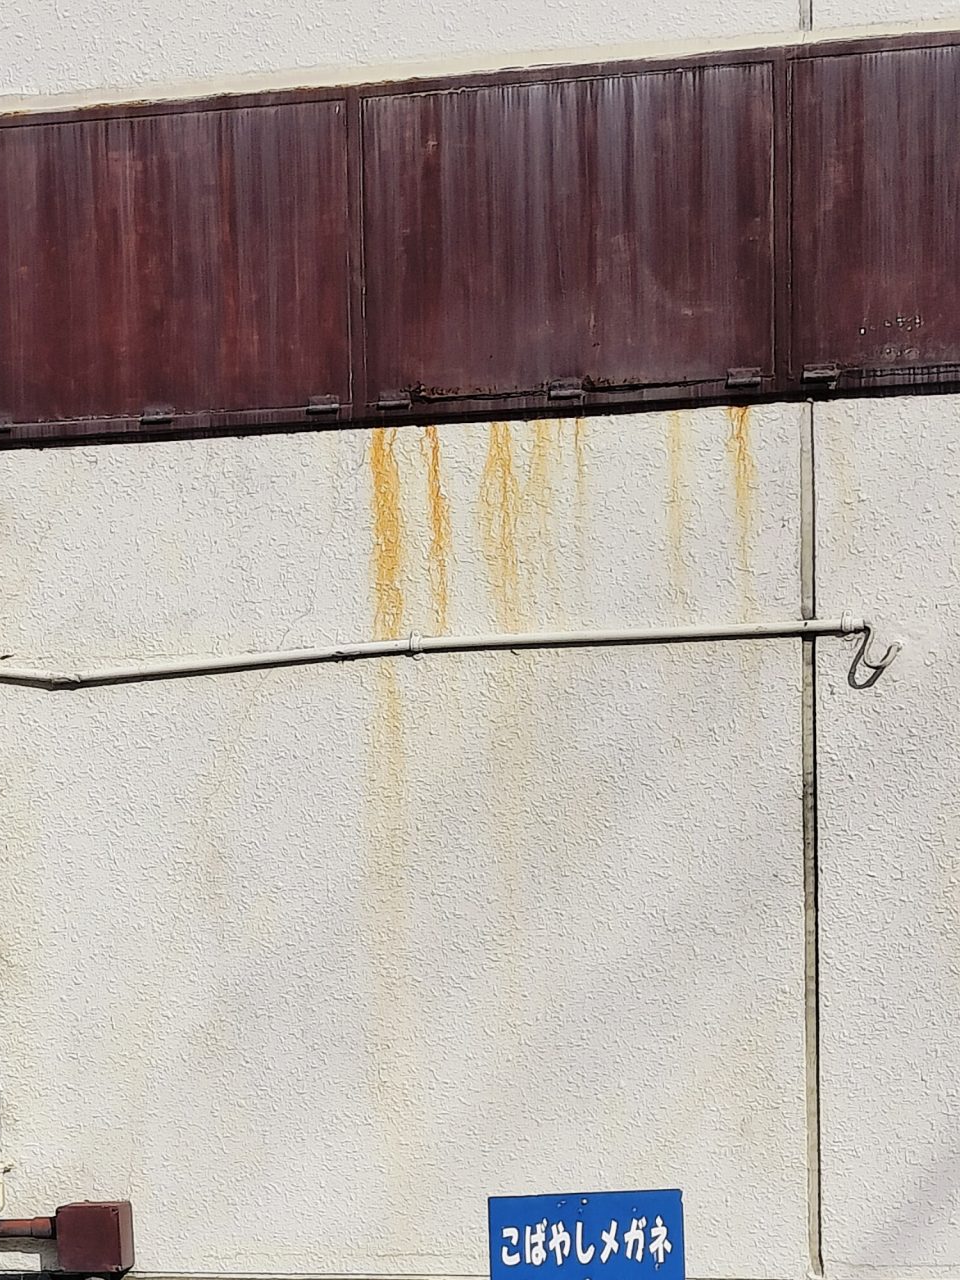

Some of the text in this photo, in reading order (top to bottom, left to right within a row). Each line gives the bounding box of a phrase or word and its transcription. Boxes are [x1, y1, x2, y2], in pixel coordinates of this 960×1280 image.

[501, 1215, 672, 1266] こばやしメガネ
